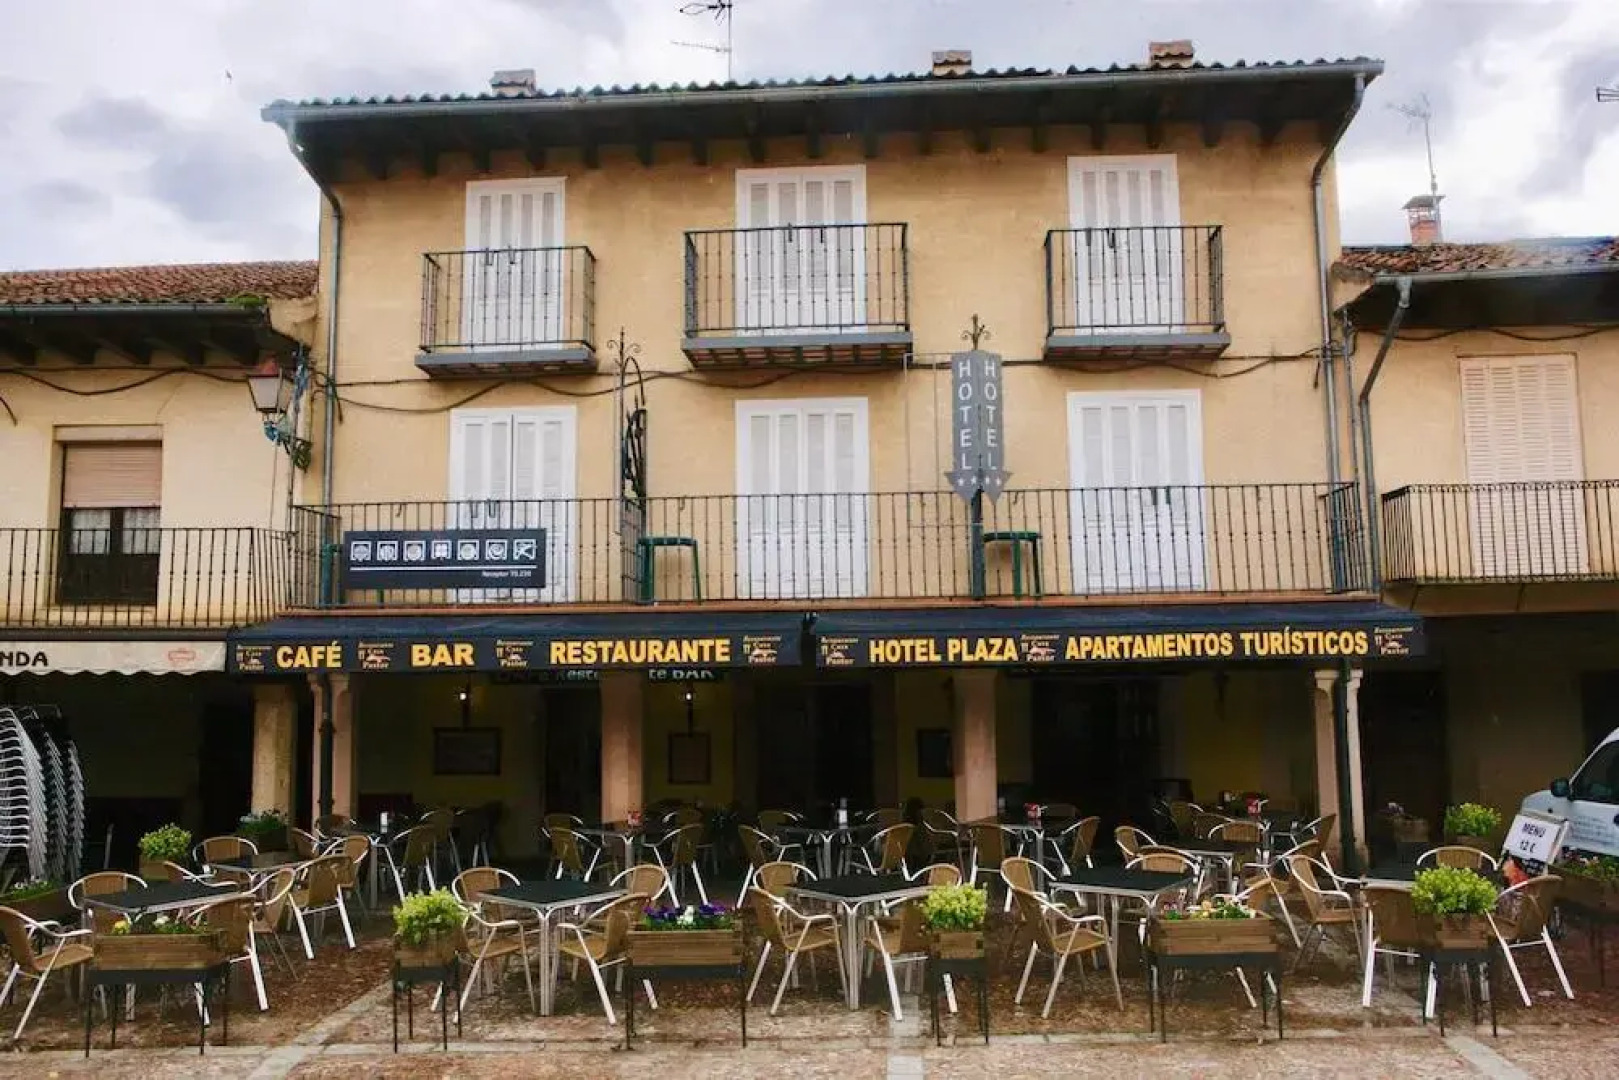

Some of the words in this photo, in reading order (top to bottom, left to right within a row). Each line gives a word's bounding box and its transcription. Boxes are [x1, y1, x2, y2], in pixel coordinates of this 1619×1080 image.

[958, 360, 972, 470] HOTEL
[984, 360, 998, 470] HOTEL
[276, 640, 343, 668] CAFÉ
[411, 643, 474, 667] BAR
[550, 638, 731, 665] RESTAURANTE
[869, 637, 942, 663] HOTEL
[948, 637, 1019, 662] PLAZA
[1065, 633, 1233, 660] APARTAMENTOS
[1240, 626, 1369, 656] TURÍSTICOS
